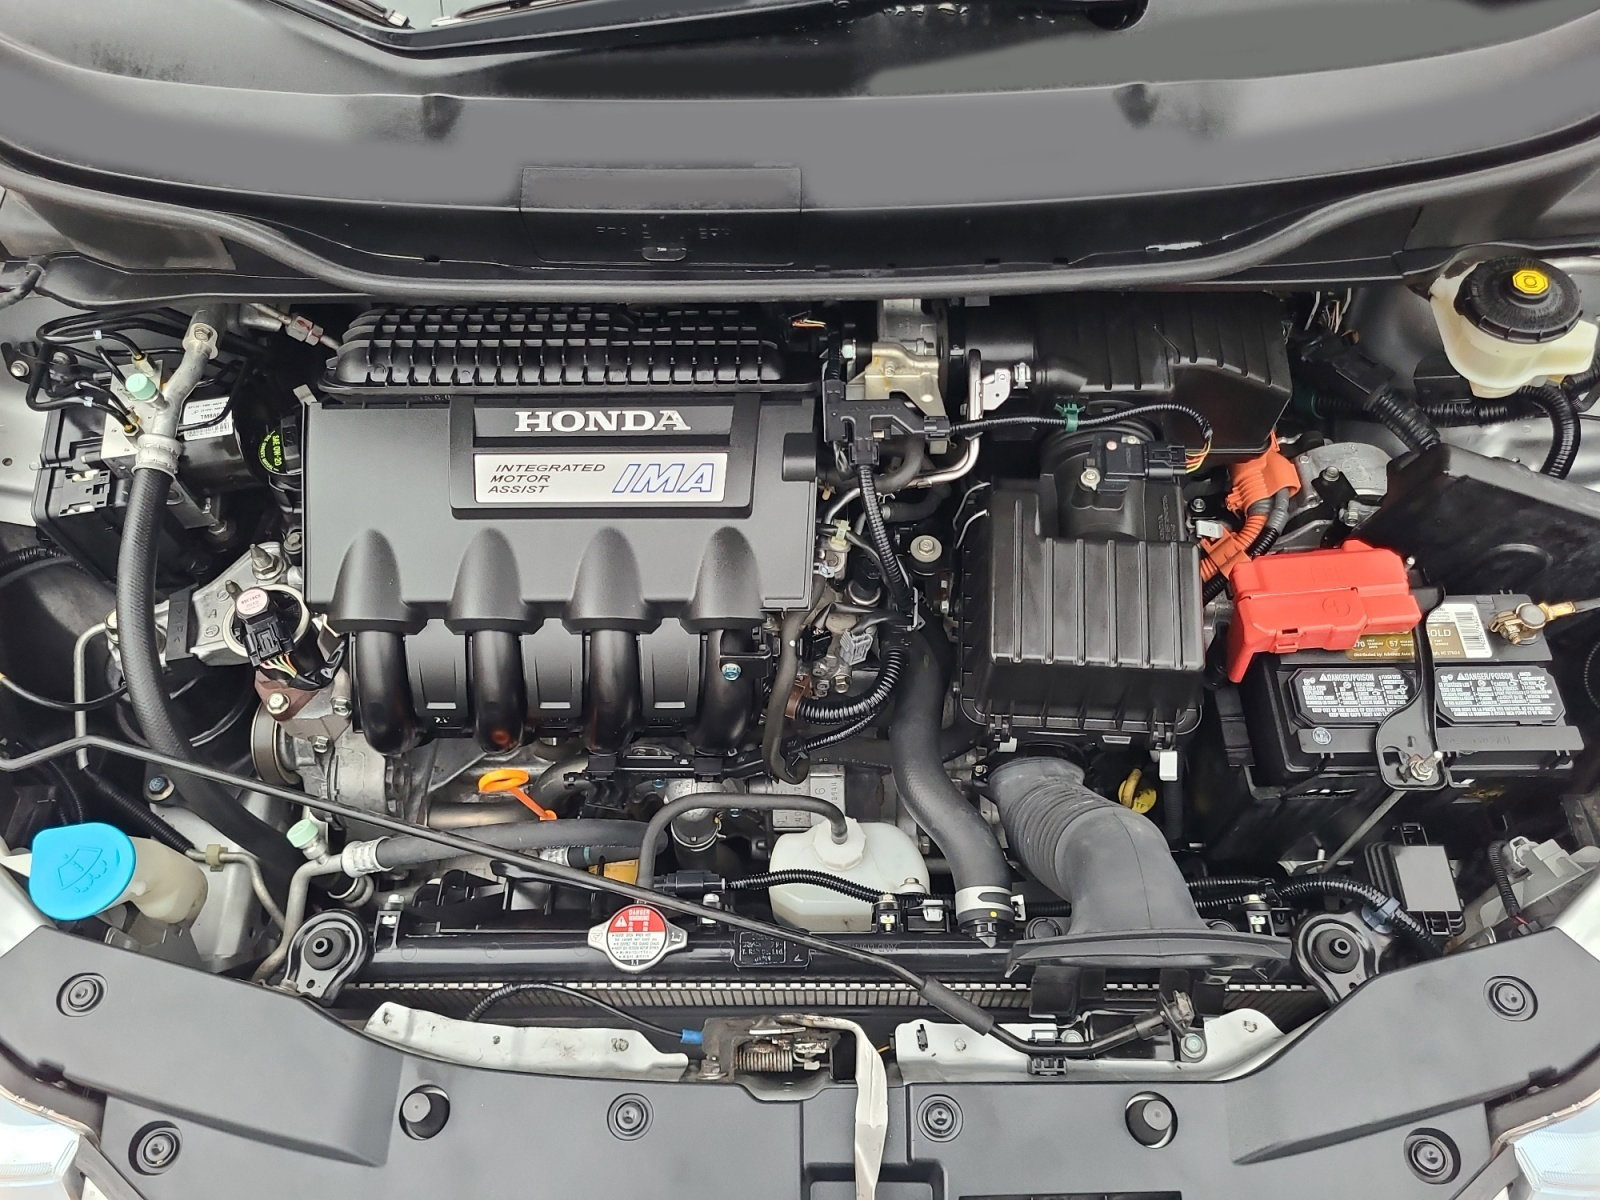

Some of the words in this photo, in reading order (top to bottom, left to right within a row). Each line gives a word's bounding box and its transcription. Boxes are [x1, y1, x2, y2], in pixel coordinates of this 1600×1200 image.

[514, 410, 691, 432] HONDA
[495, 464, 606, 473] INTEGRATED
[490, 474, 551, 483] MOTOR
[611, 463, 715, 494] IMA
[488, 485, 550, 494] ASSIST
[1326, 673, 1375, 682] DANGER/POISON
[1463, 672, 1513, 681] DANGER/POISON
